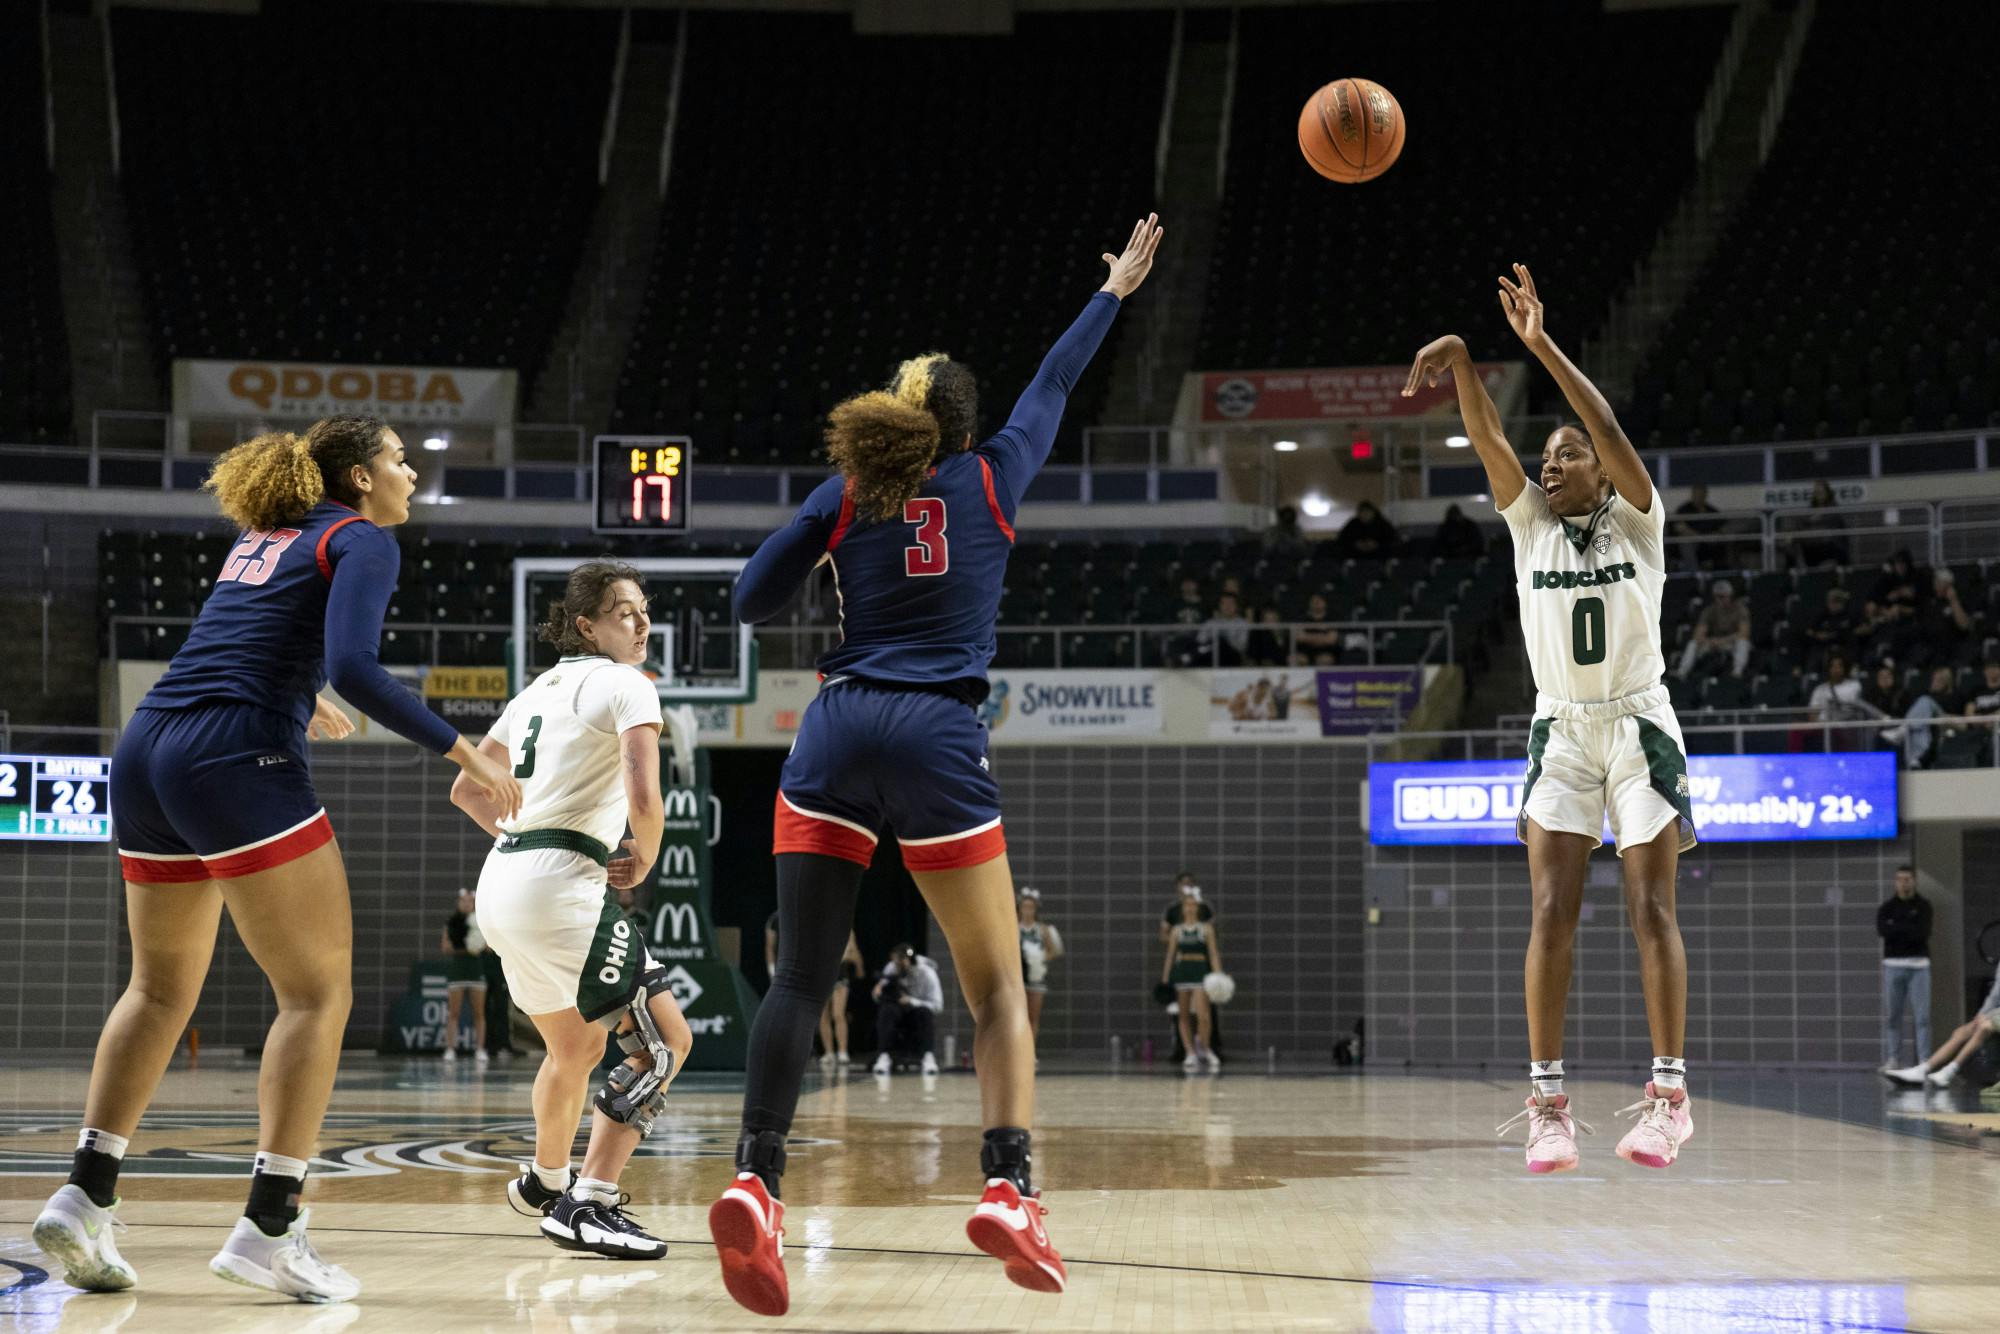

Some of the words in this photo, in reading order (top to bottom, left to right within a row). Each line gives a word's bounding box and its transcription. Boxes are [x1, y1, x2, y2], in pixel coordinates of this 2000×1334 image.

[228, 365, 464, 411] QDOBA
[631, 447, 681, 476] 1:12
[633, 476, 671, 520] 17
[1765, 486, 1862, 503] RESEED
[904, 497, 949, 577] 3
[216, 527, 302, 586] 23
[1532, 561, 1637, 590] BOBCATS
[1572, 596, 1607, 666] 0
[432, 674, 470, 690] THE
[1020, 682, 1155, 716] SNOWVILLE
[514, 715, 543, 778] 3
[51, 780, 97, 815] 26
[1401, 785, 1490, 821] BUD
[1689, 775, 1722, 803] oy
[1690, 795, 1816, 829] ponsibly
[1820, 795, 1873, 823] 21+
[599, 919, 631, 985] OHIO
